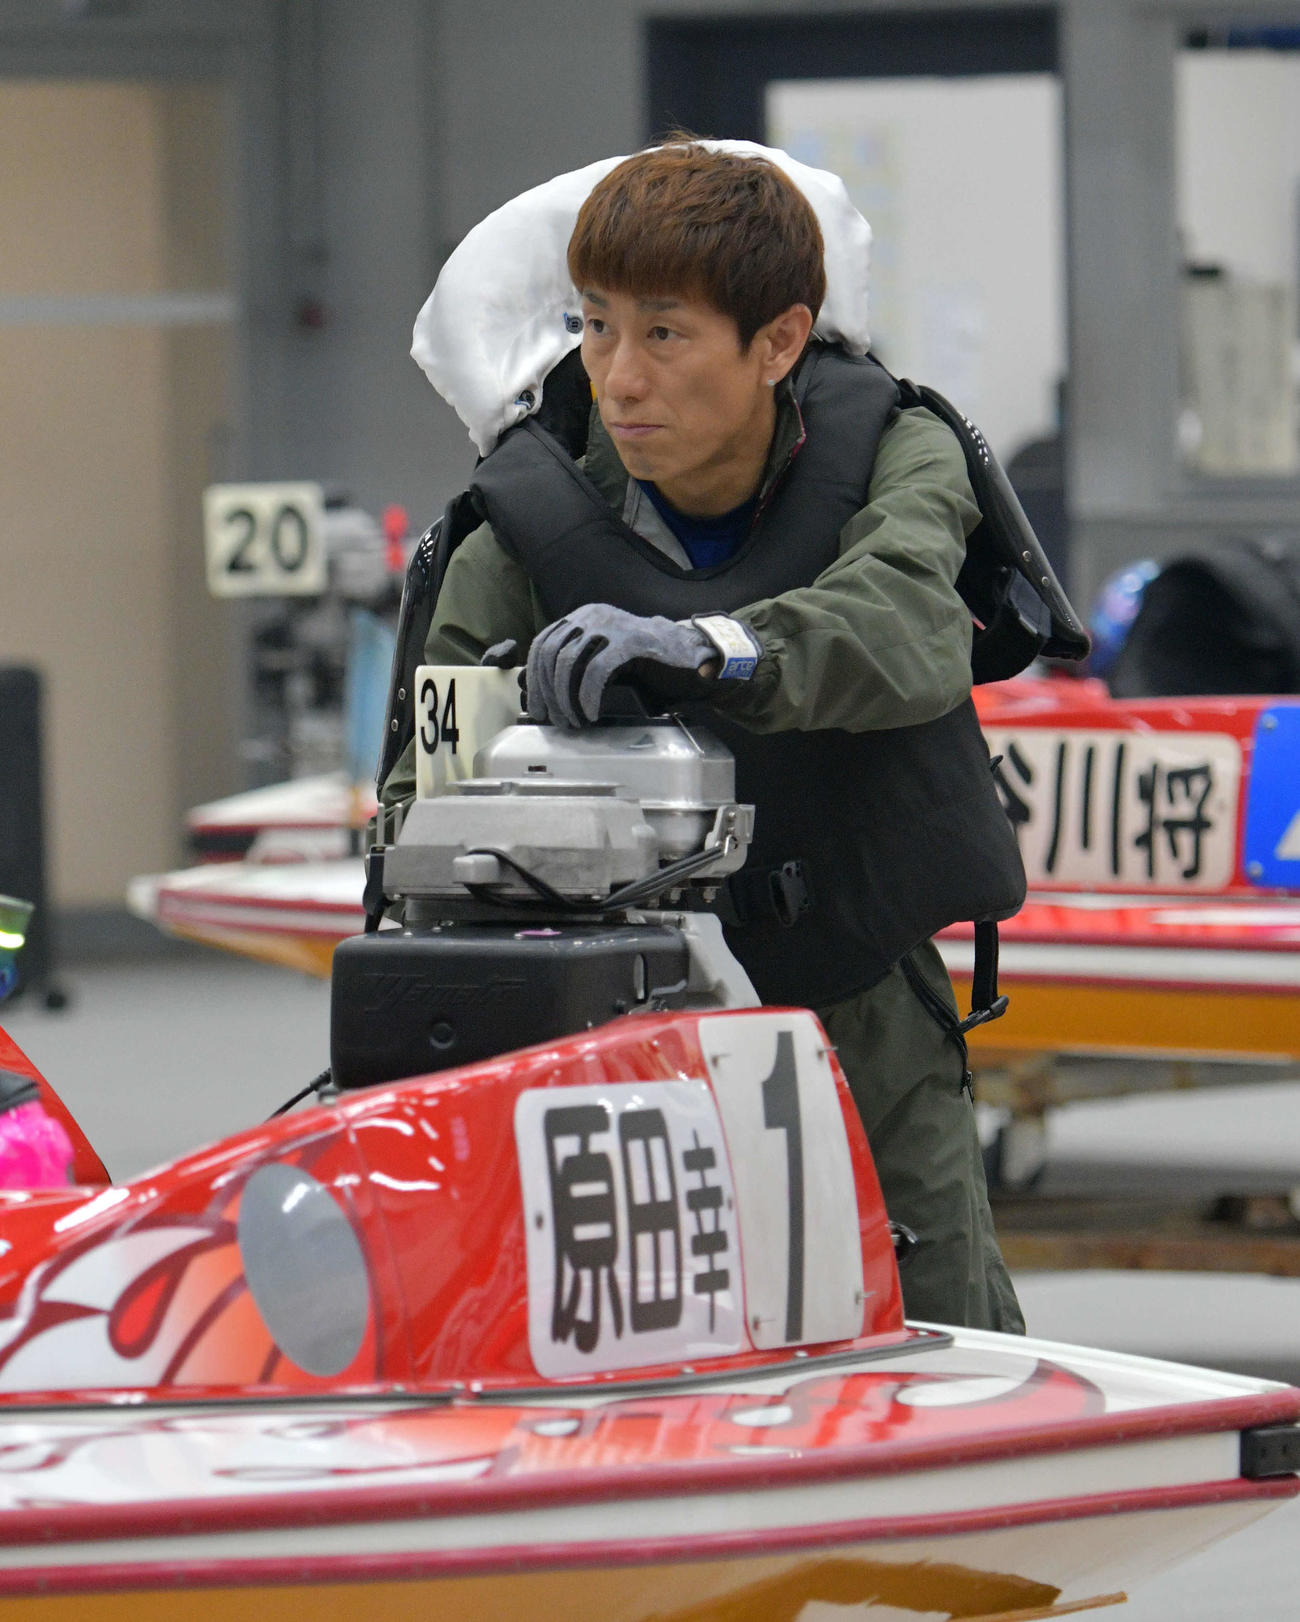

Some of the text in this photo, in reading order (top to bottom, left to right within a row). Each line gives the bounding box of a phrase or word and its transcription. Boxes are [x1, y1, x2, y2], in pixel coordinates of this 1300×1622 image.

[226, 505, 308, 574] 20
[420, 678, 459, 755] 34
[543, 1104, 731, 1355] 原田幸
[761, 1030, 805, 1343] 1
